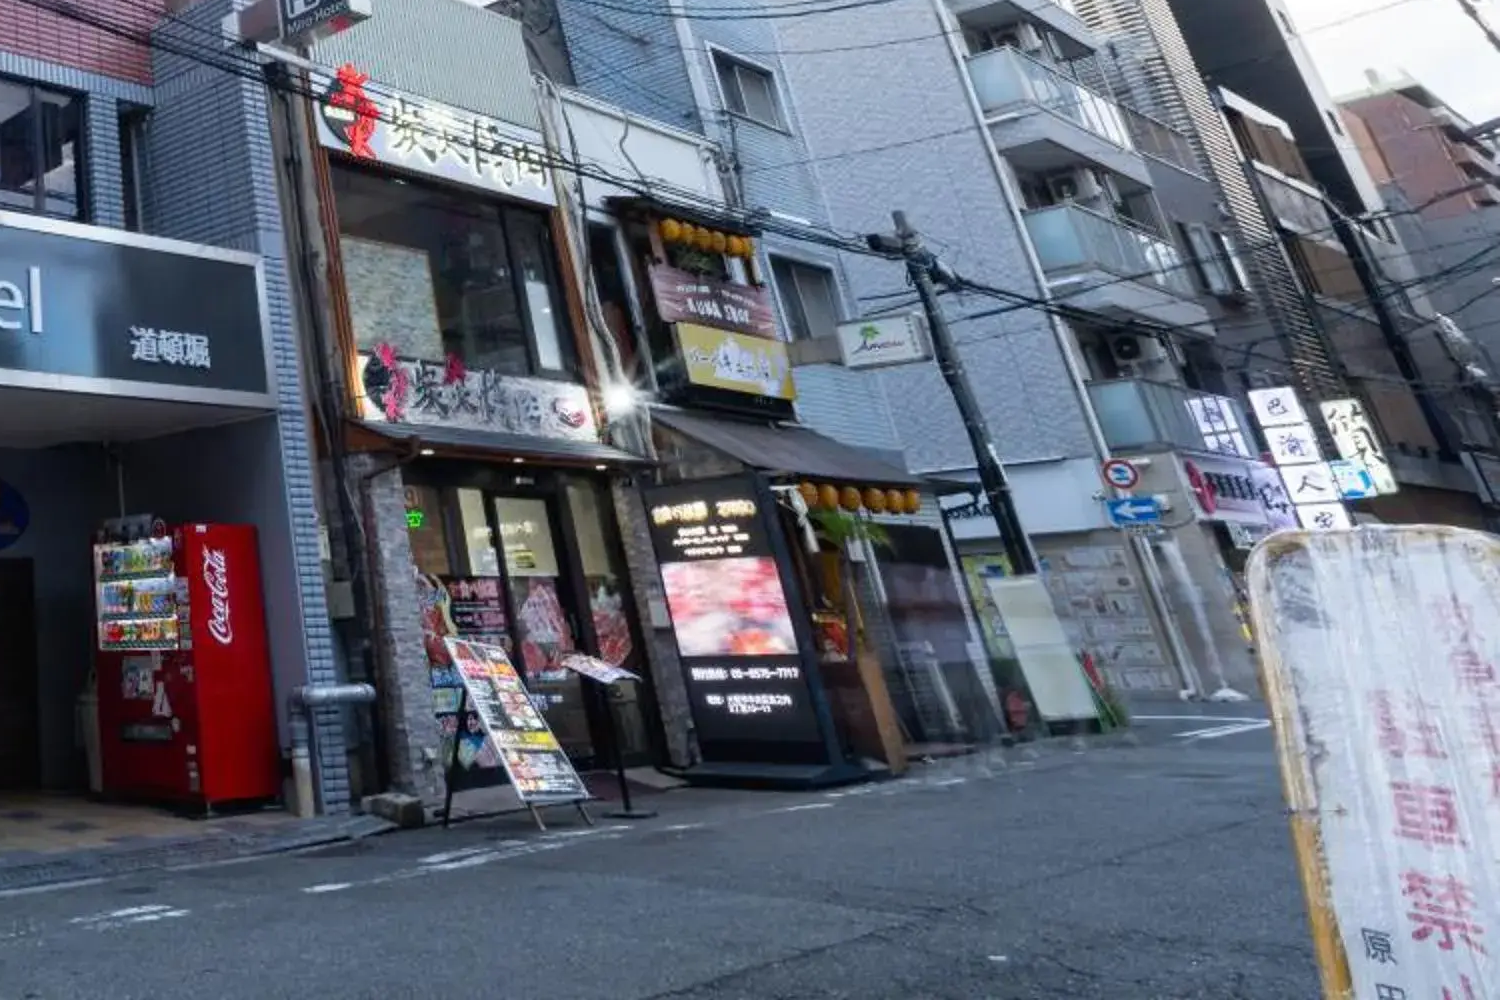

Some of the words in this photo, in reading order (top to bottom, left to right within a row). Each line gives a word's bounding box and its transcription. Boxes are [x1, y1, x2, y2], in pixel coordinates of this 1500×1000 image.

[129, 325, 212, 369] 道頓堀
[202, 544, 234, 646] Coca-Cola
